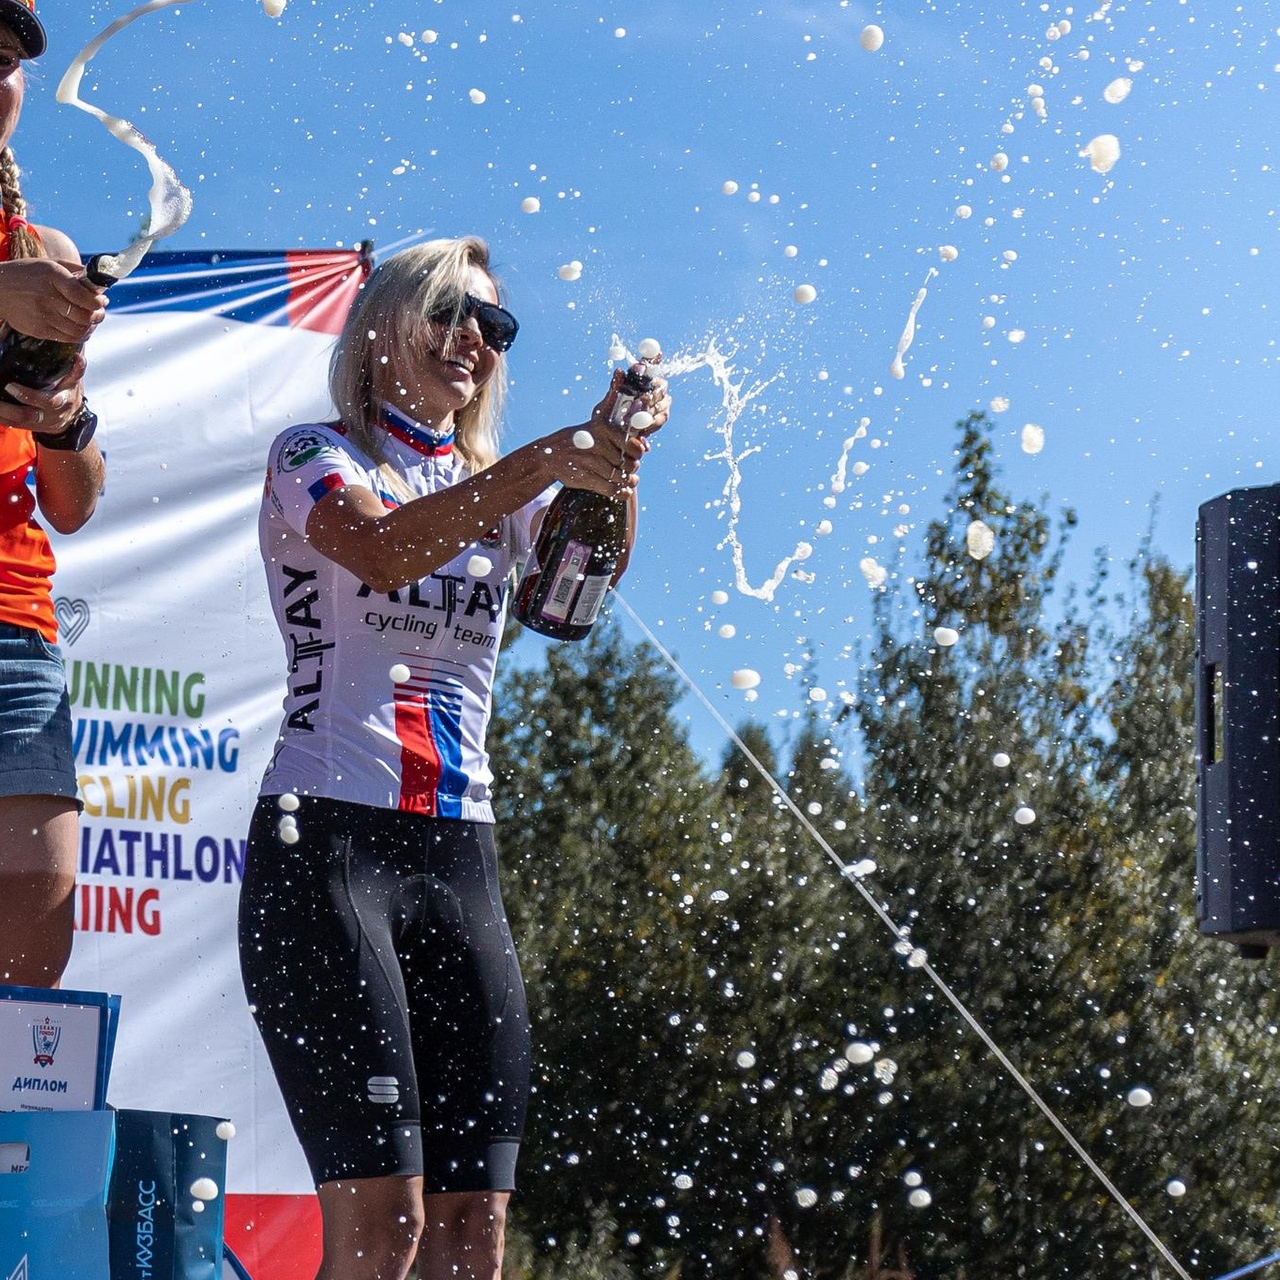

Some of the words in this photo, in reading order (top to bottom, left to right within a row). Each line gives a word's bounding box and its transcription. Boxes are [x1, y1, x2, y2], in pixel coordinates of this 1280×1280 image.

[365, 611, 438, 640] cycling
[454, 623, 497, 649] team
[12, 1076, 68, 1093] ДИПЛОМ
